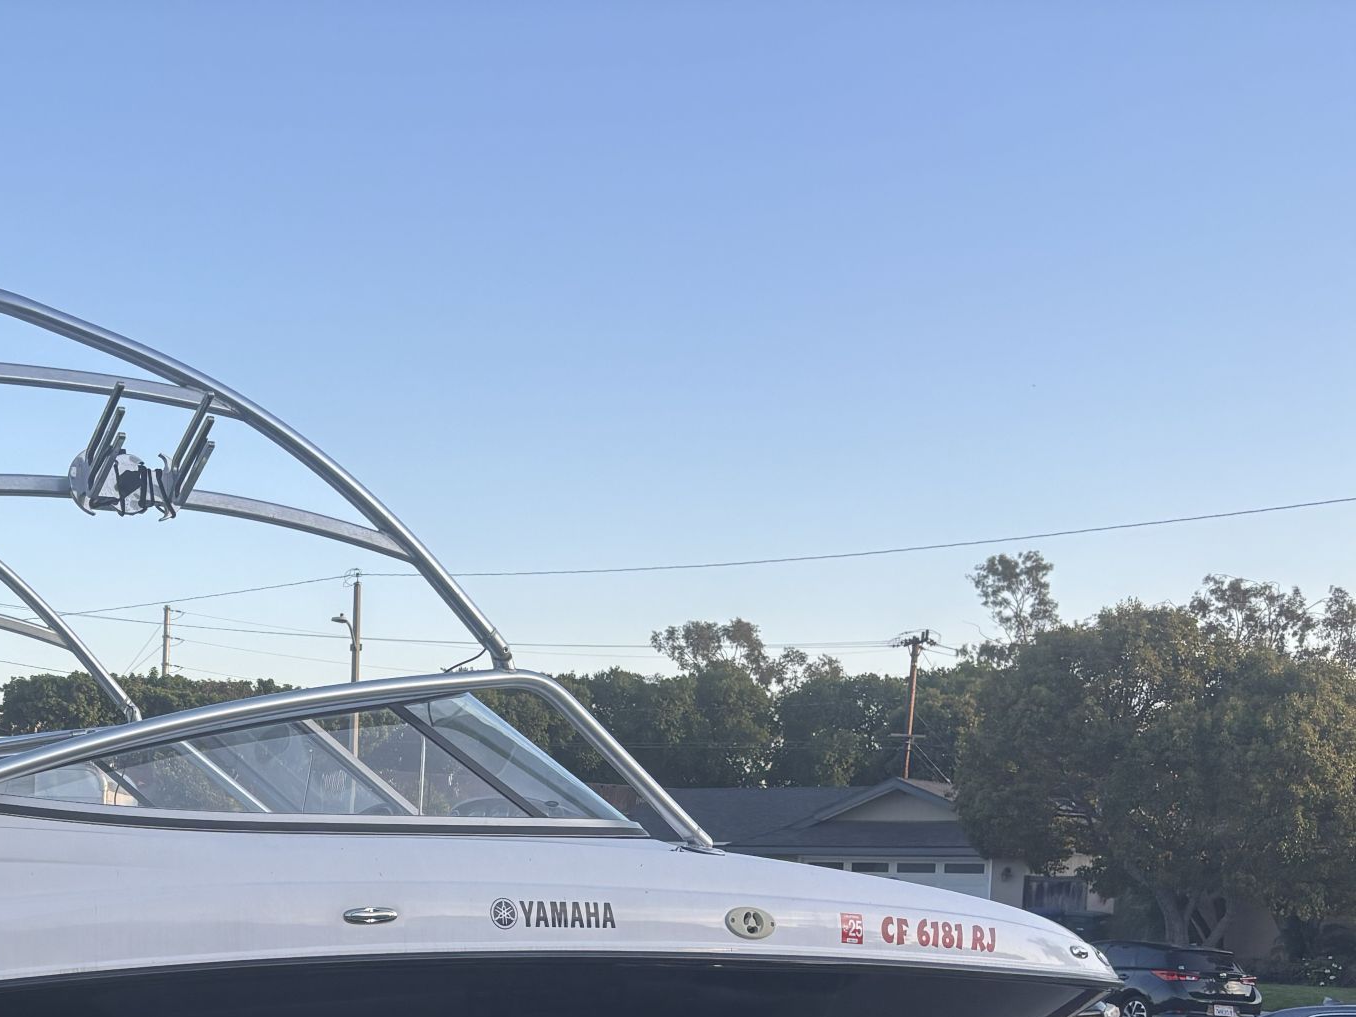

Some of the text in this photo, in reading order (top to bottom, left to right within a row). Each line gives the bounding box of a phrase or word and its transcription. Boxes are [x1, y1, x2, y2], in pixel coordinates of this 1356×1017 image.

[519, 900, 616, 929] YAMAHA
[848, 919, 863, 938] 25
[881, 916, 996, 953] CF 6181 RJ
